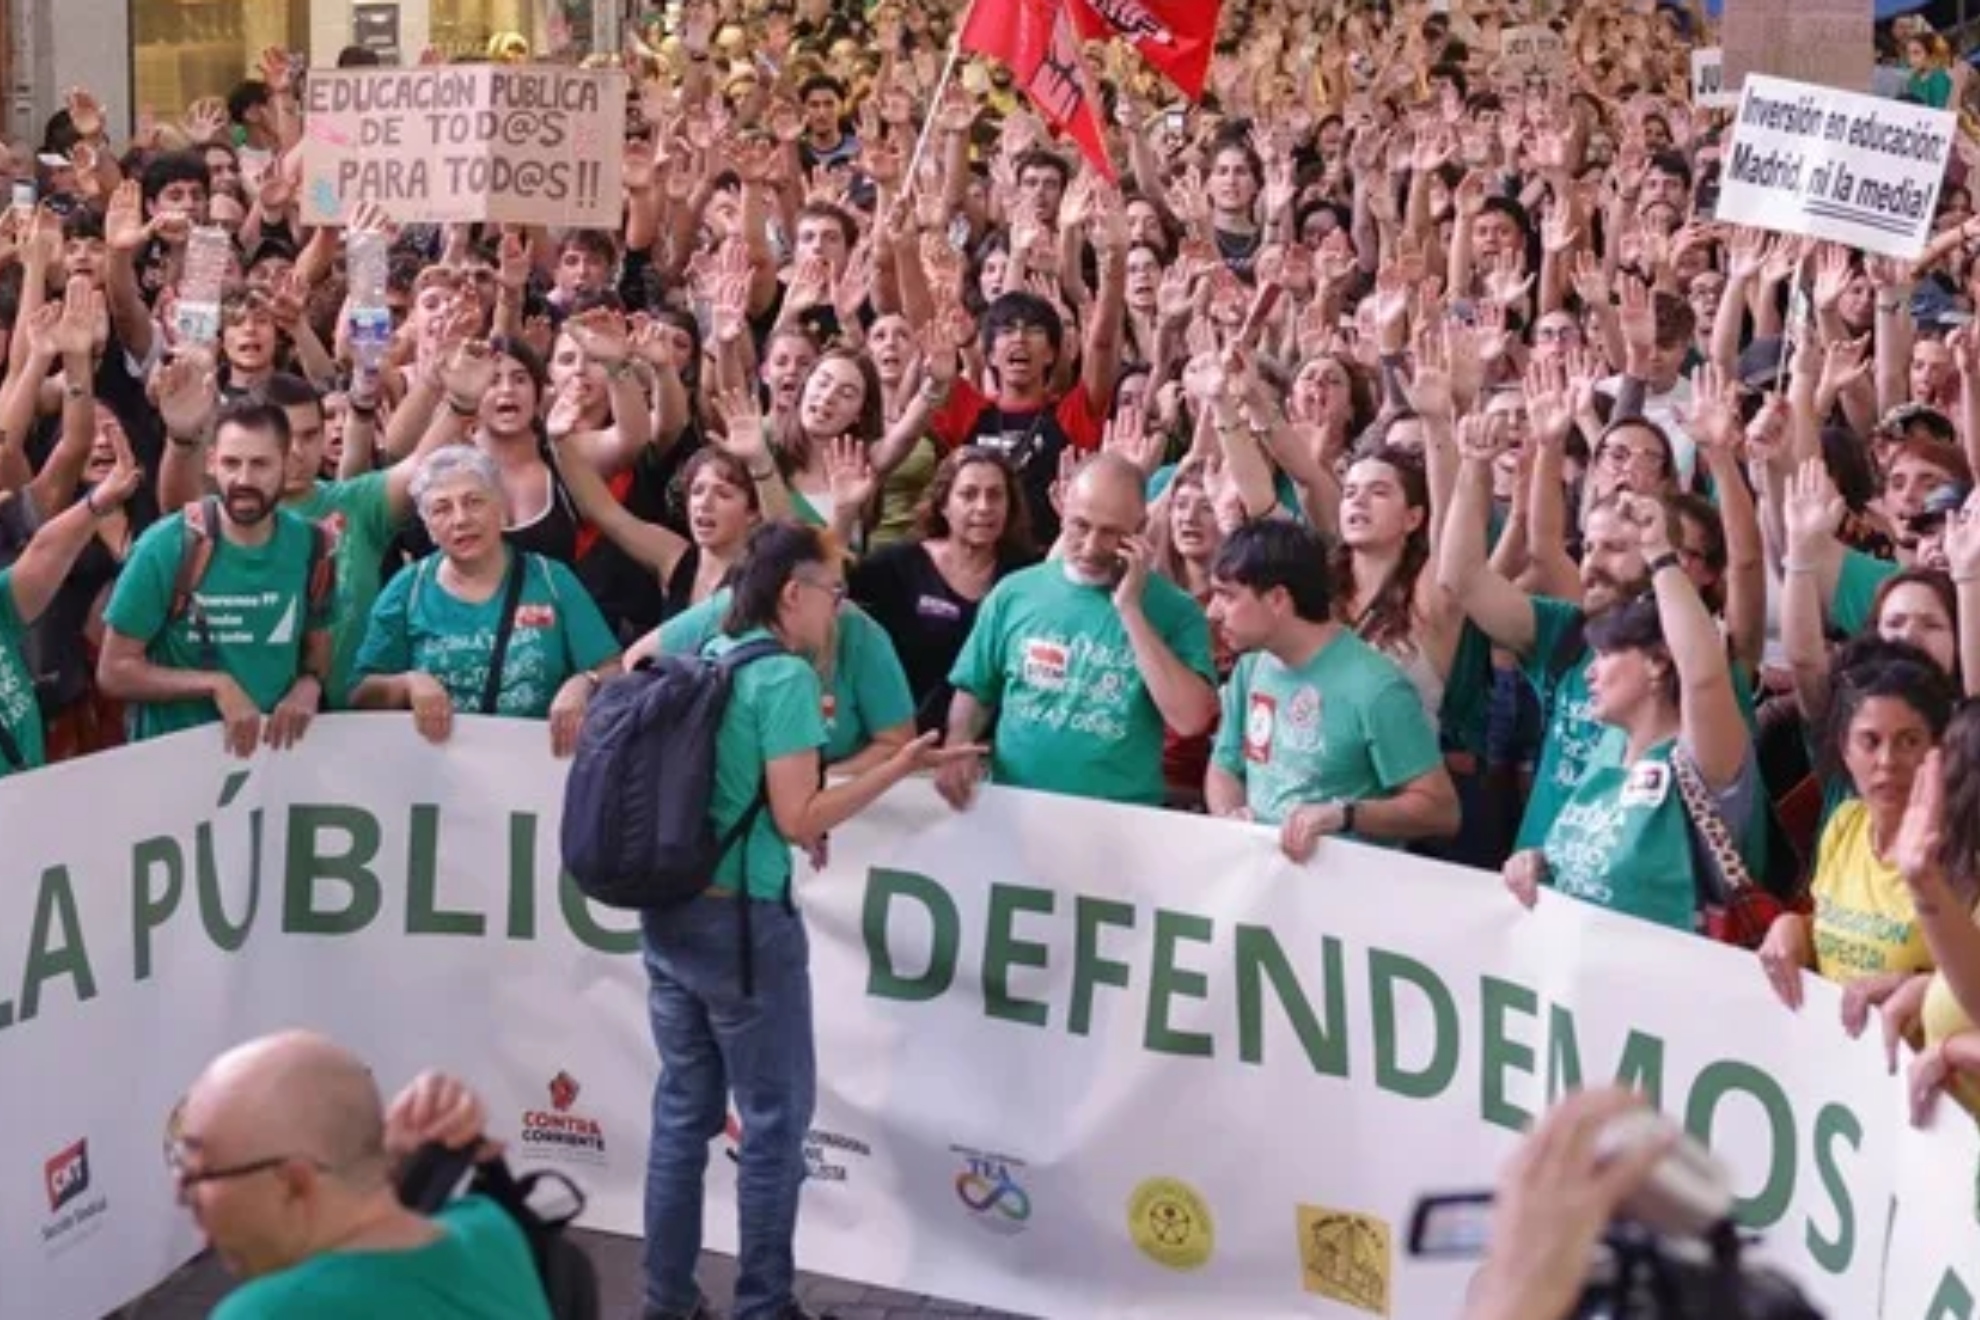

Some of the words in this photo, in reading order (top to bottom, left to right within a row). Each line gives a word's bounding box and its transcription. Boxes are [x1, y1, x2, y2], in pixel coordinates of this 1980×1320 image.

[360, 116, 403, 146] DE
[426, 110, 566, 147] TOD@S
[1743, 86, 1823, 137] Inversión
[1824, 113, 1848, 141] en
[337, 160, 428, 198] PARA
[444, 157, 570, 200] TOD@S
[1806, 160, 1833, 196] ni
[1832, 162, 1854, 201] la
[1856, 174, 1933, 219] media!
[0, 864, 98, 1029] A
[862, 866, 1863, 1274] DEFENDEMOS
[522, 1130, 605, 1151] CORRIENTE
[523, 1111, 601, 1135] CONTRA
